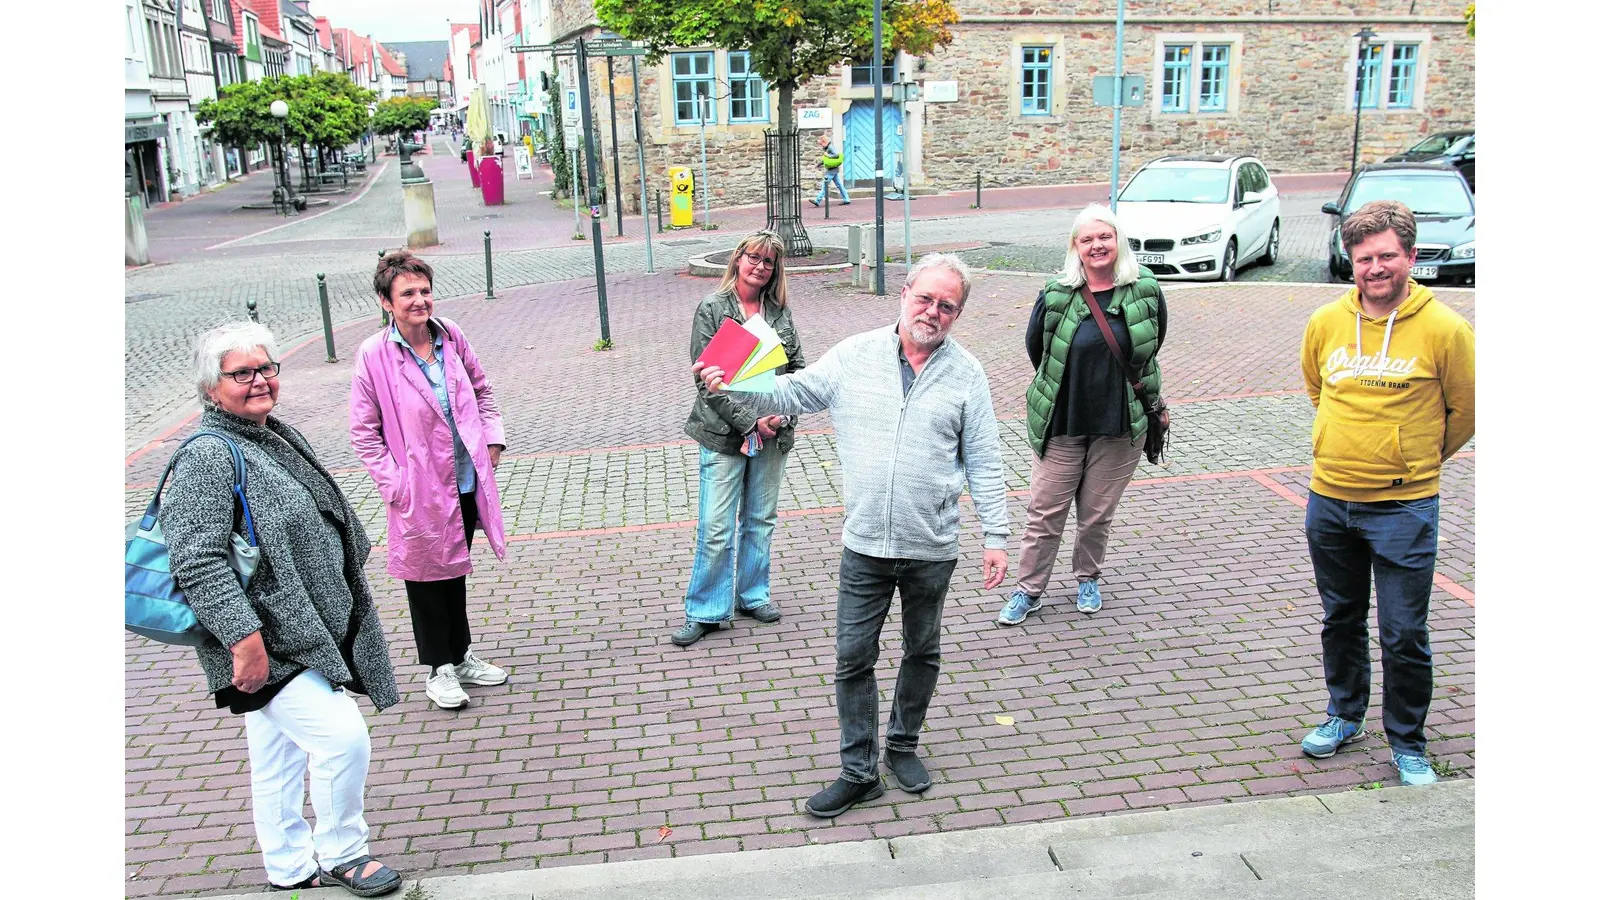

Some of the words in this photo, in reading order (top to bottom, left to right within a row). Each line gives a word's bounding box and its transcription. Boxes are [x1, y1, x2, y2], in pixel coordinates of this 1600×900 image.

[803, 110, 820, 119] ZAG
[1425, 267, 1437, 275] 19
[1327, 346, 1417, 375] Original
[1388, 381, 1410, 389] BRAND
